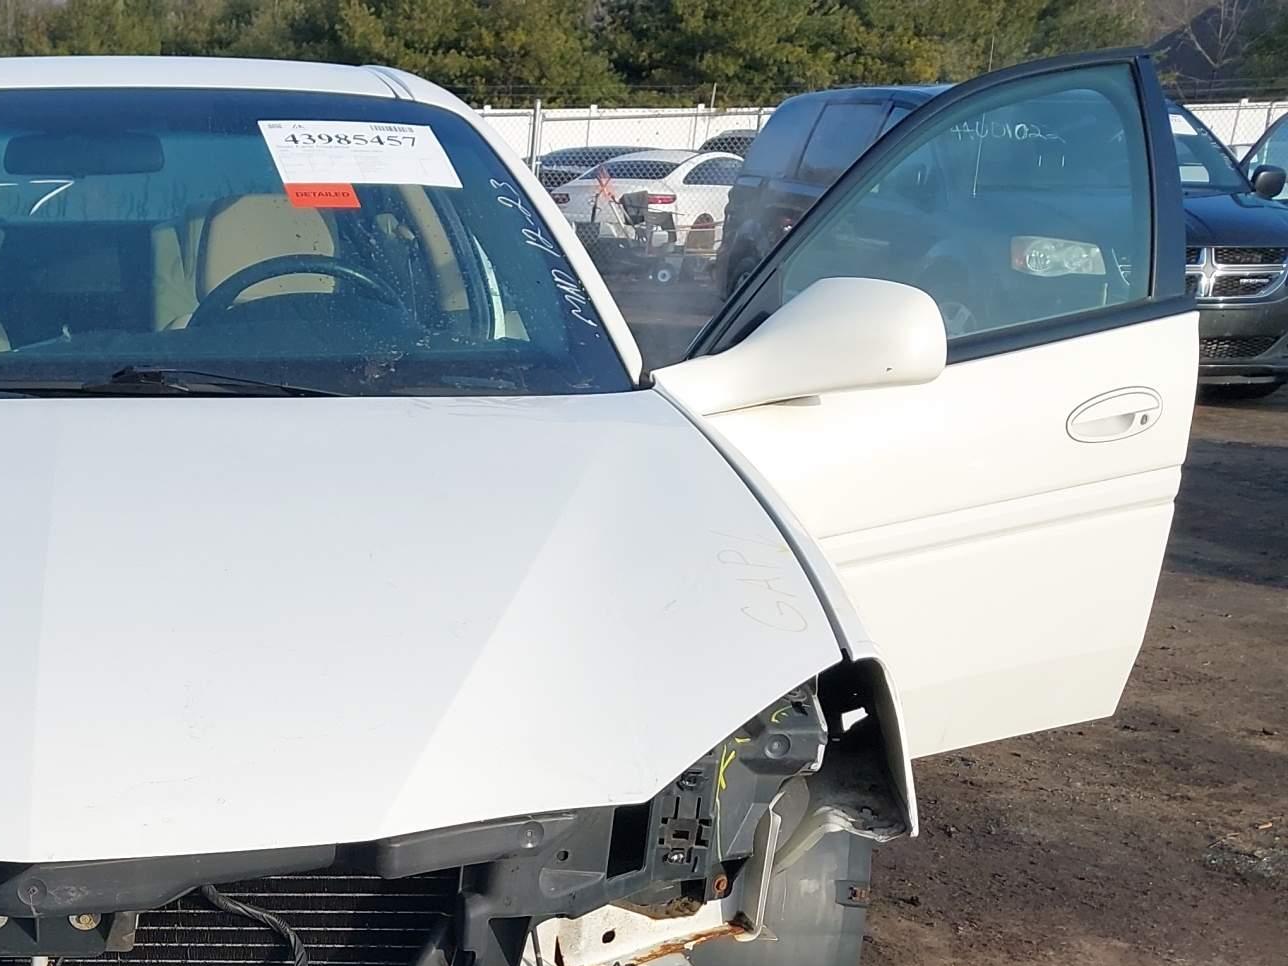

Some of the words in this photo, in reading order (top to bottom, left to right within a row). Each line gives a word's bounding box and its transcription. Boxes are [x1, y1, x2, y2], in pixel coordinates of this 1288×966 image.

[284, 132, 416, 147] 43985457
[295, 190, 351, 199] DETAILED
[489, 178, 561, 258] 12-23
